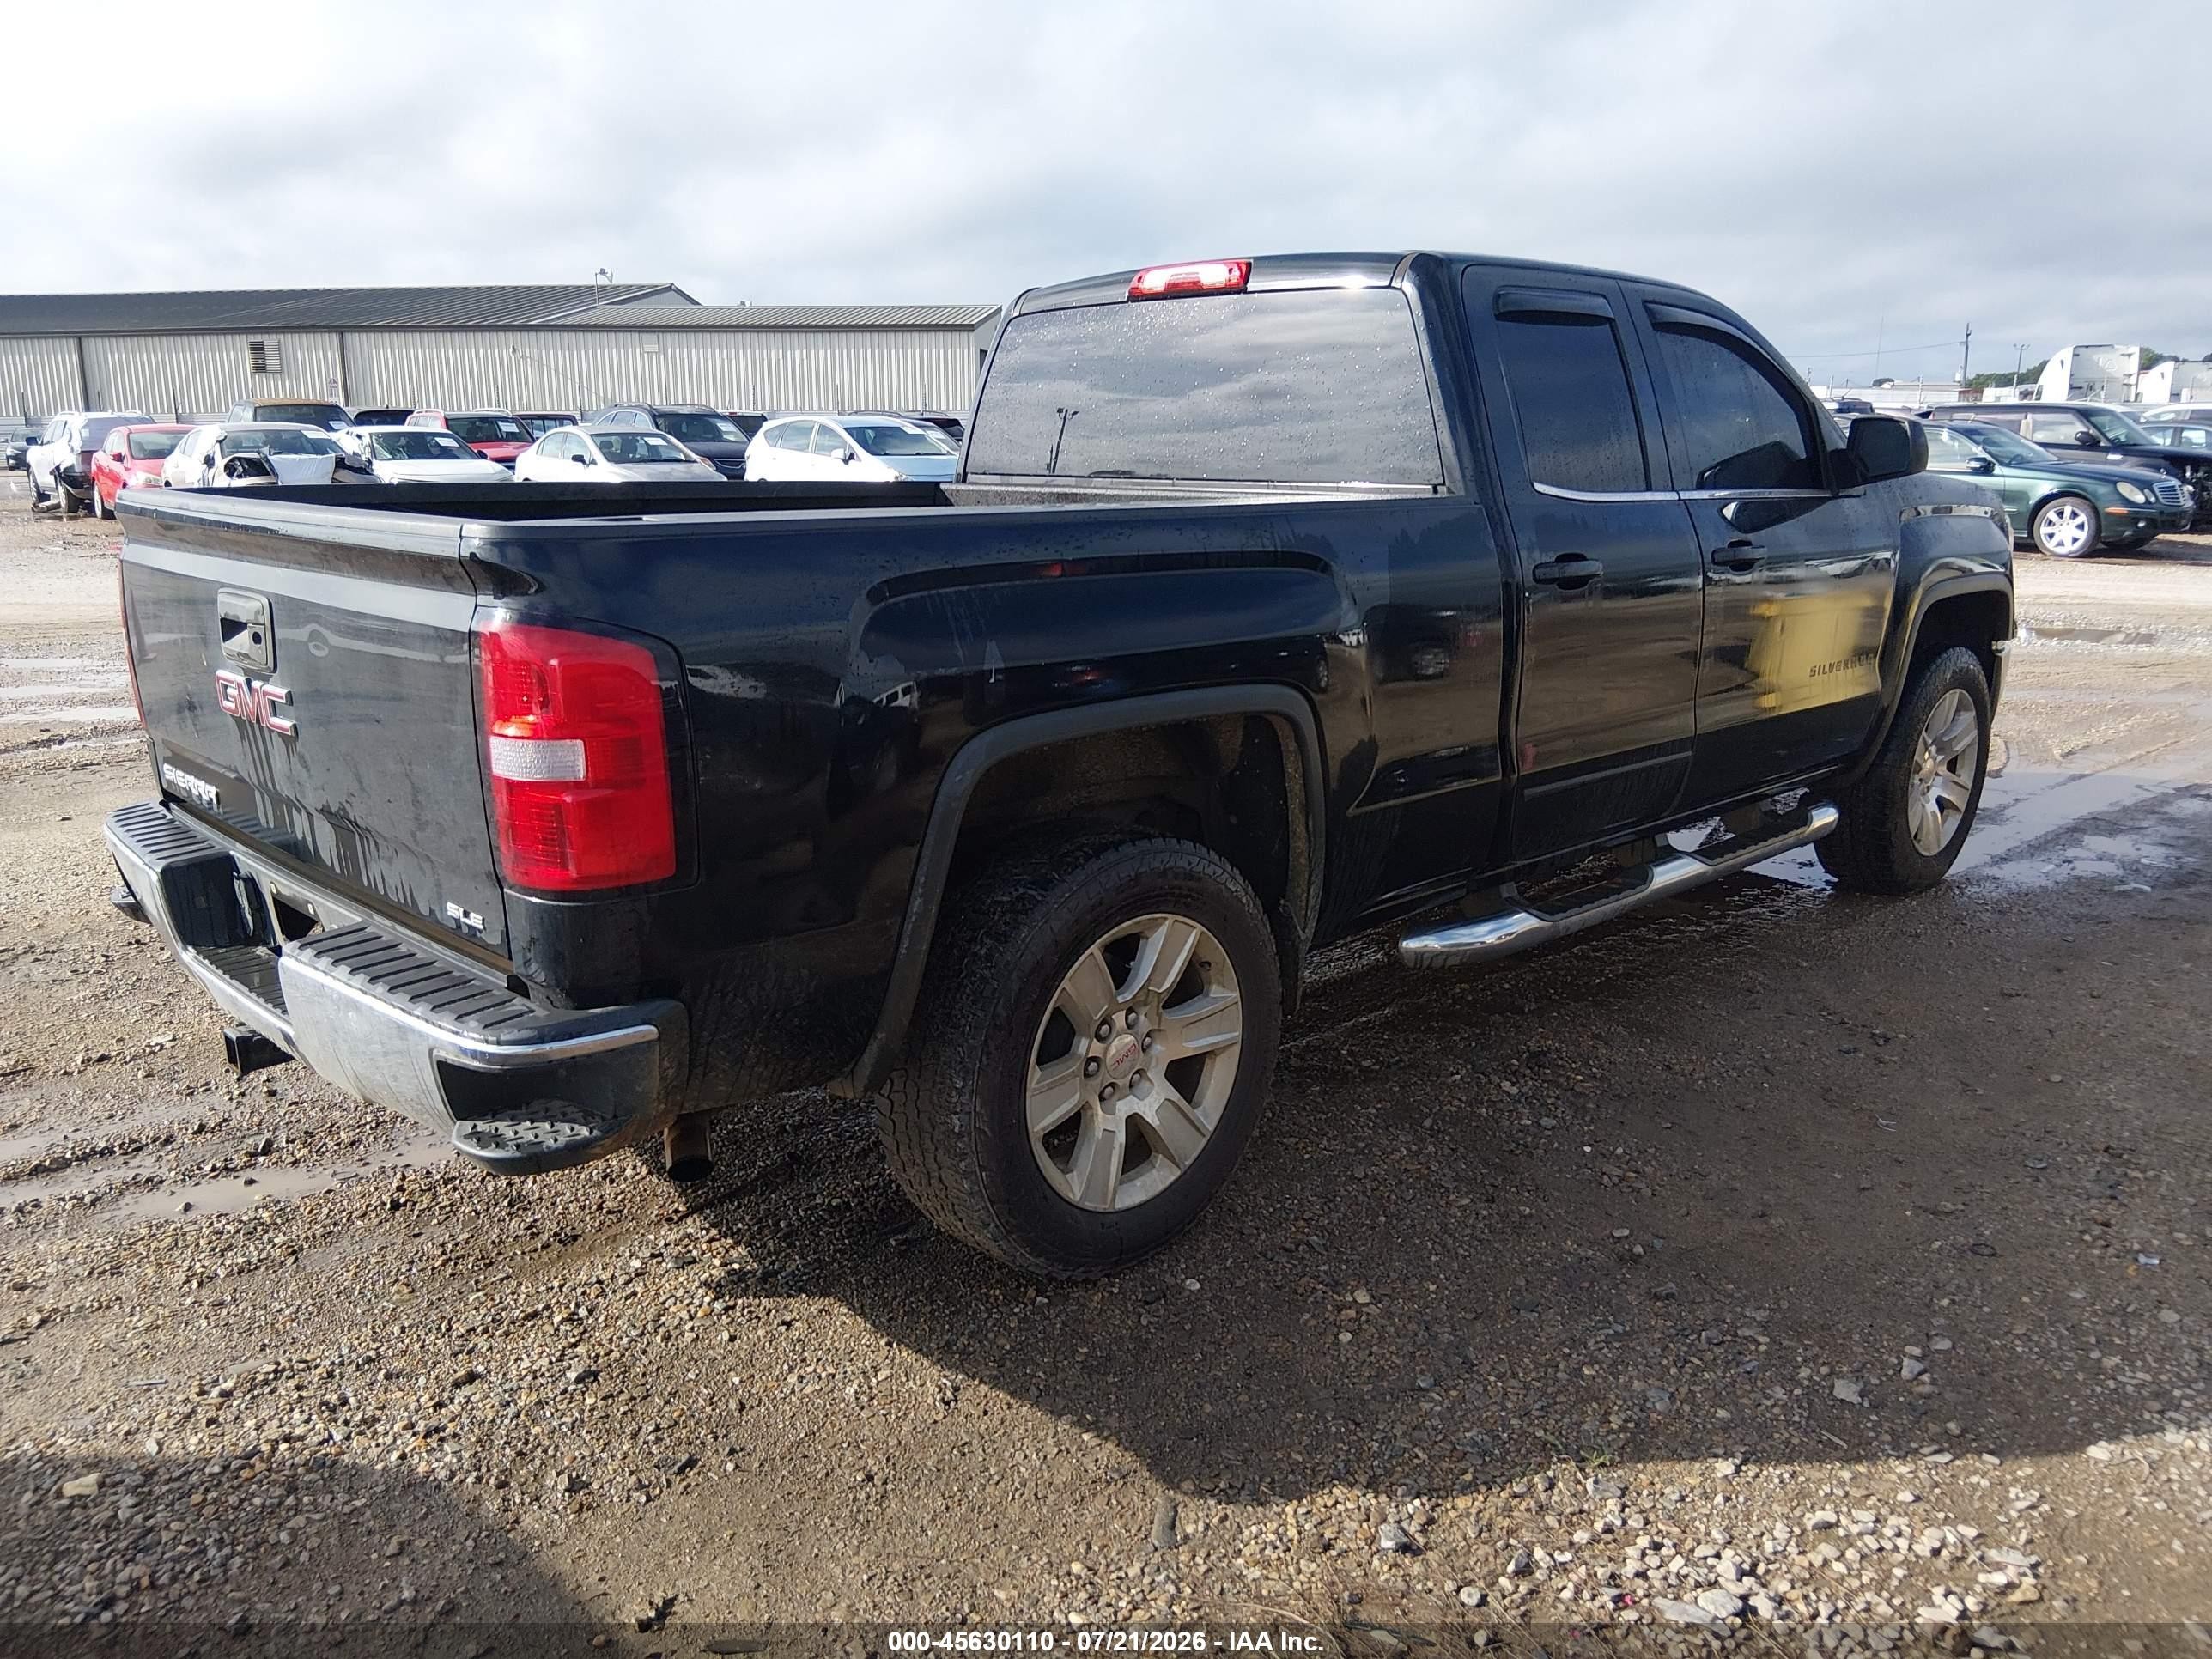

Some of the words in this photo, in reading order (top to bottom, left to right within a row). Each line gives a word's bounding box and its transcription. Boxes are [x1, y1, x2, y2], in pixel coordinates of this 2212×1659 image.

[216, 670, 298, 738] GMC
[163, 763, 217, 805] SIERRA
[447, 902, 484, 929] SLE
[1112, 1043, 1137, 1071] GMC
